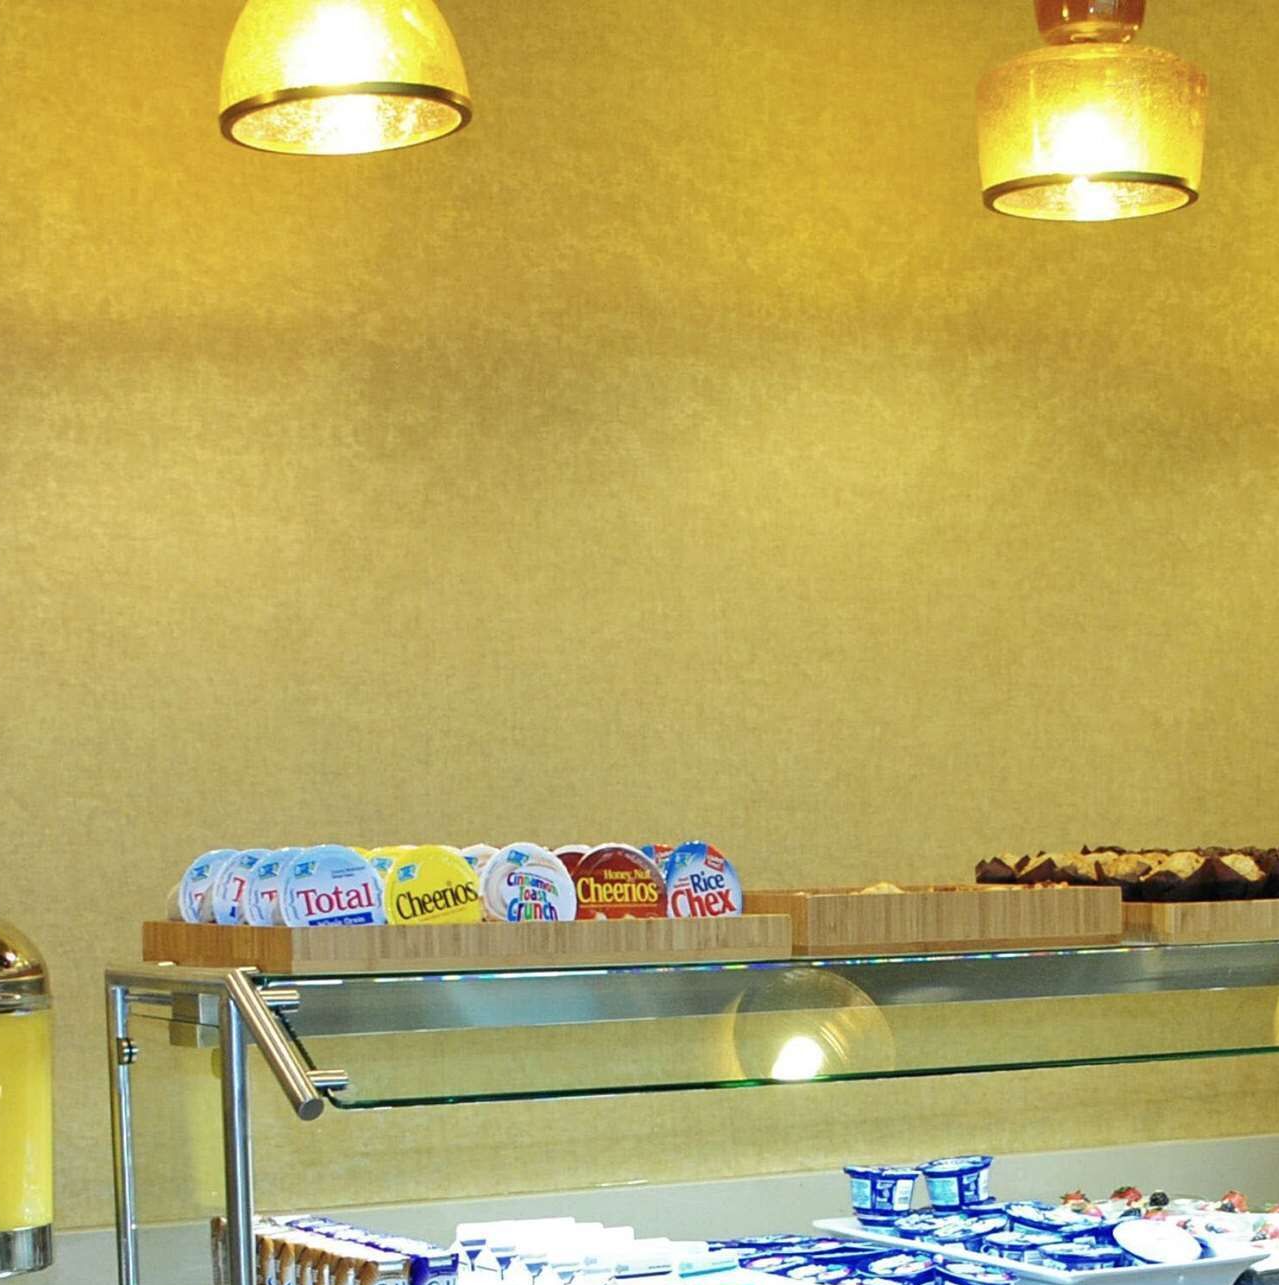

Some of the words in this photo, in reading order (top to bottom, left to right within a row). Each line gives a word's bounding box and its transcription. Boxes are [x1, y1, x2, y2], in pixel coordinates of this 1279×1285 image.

[603, 869, 631, 881] Honey
[633, 869, 651, 879] Nut
[690, 870, 725, 893] Rice
[296, 882, 375, 917] Total
[396, 881, 479, 920] Cheerios
[519, 886, 548, 902] Toast
[576, 877, 659, 903] Cheerios
[507, 898, 559, 921] Crunch
[671, 888, 737, 917] Chex
